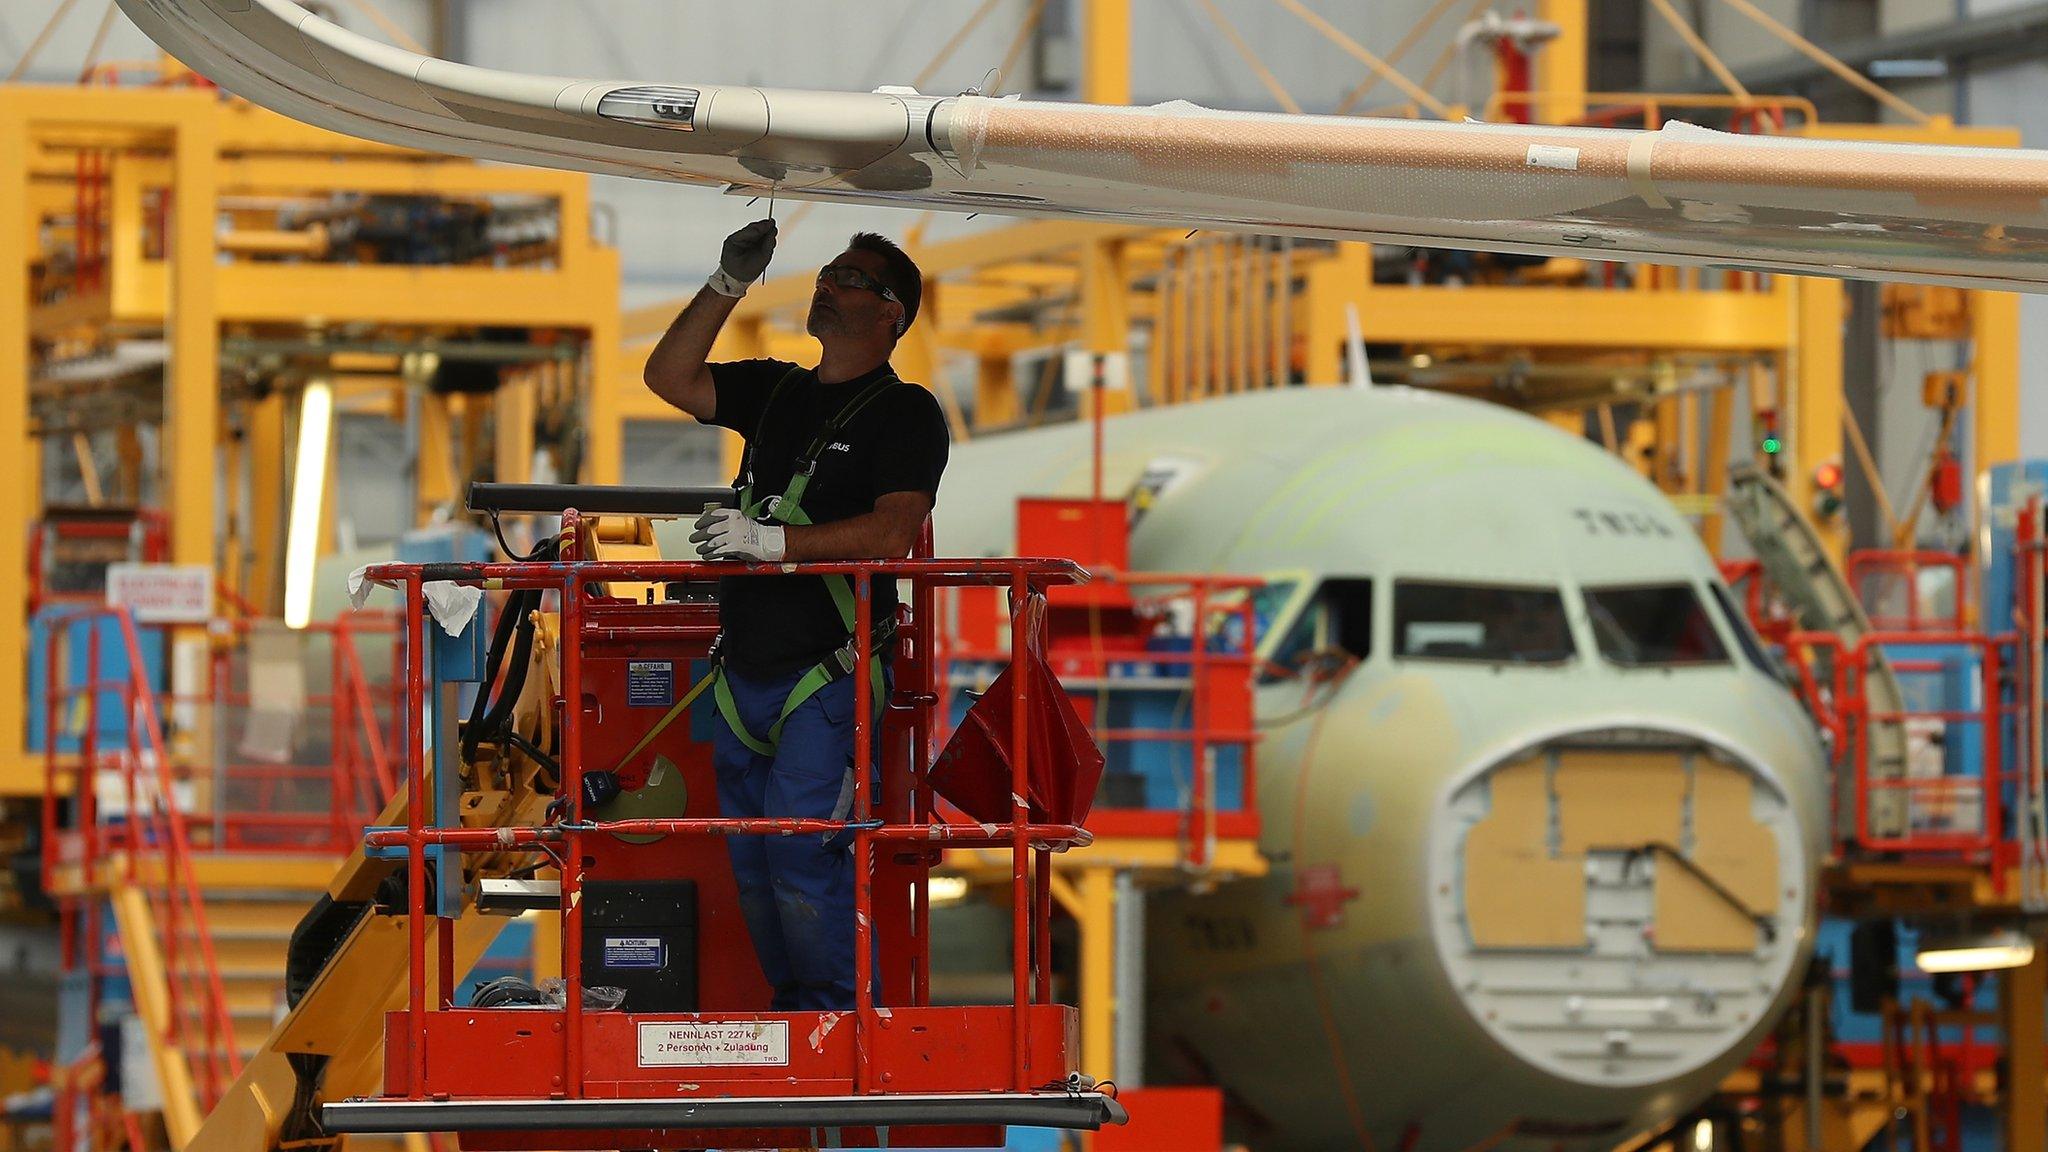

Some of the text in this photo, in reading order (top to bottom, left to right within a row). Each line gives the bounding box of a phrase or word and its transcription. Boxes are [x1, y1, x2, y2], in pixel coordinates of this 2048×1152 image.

[669, 1030, 758, 1040] NENNLAST 227 kg
[658, 1043, 665, 1052] 2
[667, 1043, 712, 1053] Personen
[724, 1043, 769, 1053] Zuladung
